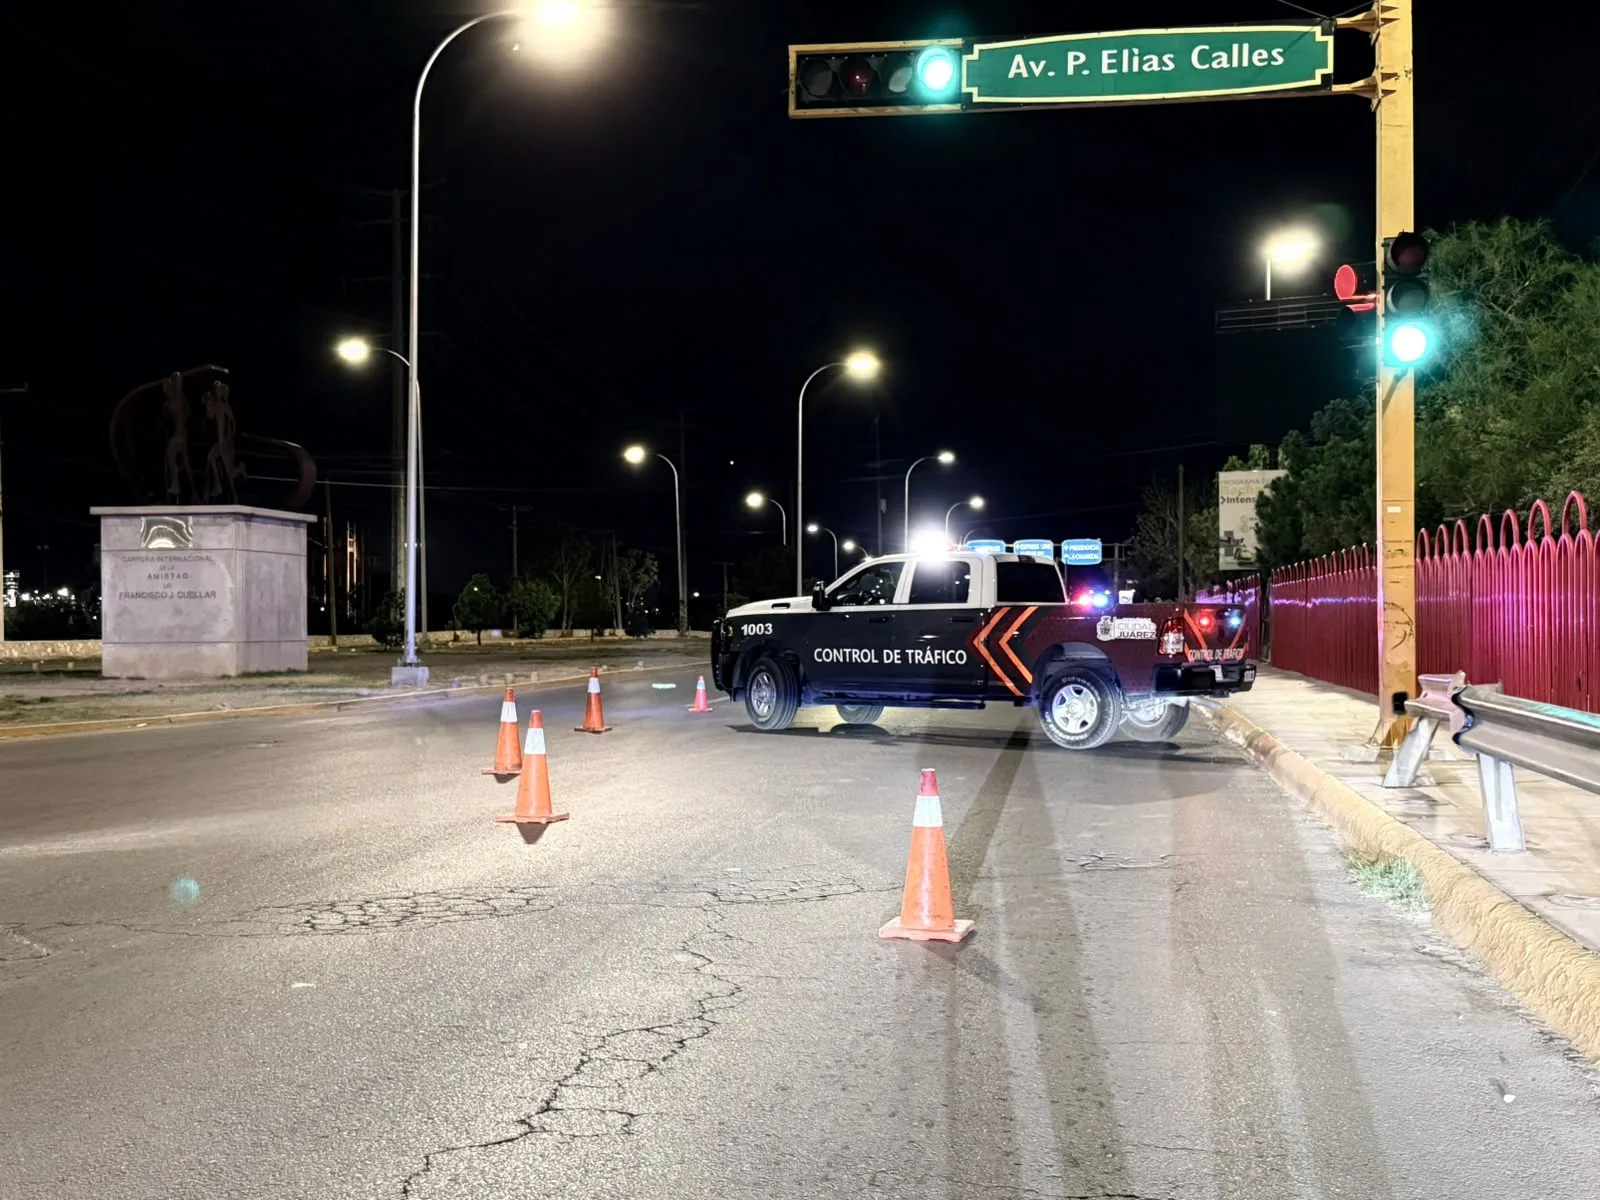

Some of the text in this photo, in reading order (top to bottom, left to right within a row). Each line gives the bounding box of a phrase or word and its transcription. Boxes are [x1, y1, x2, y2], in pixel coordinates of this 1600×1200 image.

[1008, 54, 1056, 79] Av.
[1067, 51, 1090, 76] P.
[1190, 42, 1285, 70] Calles
[119, 591, 168, 600] FRANCISCO
[177, 590, 217, 599] CUELLAR
[741, 623, 773, 636] 1003
[1117, 622, 1156, 631] CIUDAD
[1118, 630, 1156, 639] JUÁREZ
[814, 646, 967, 664] CONTROL DE TRÁFICO
